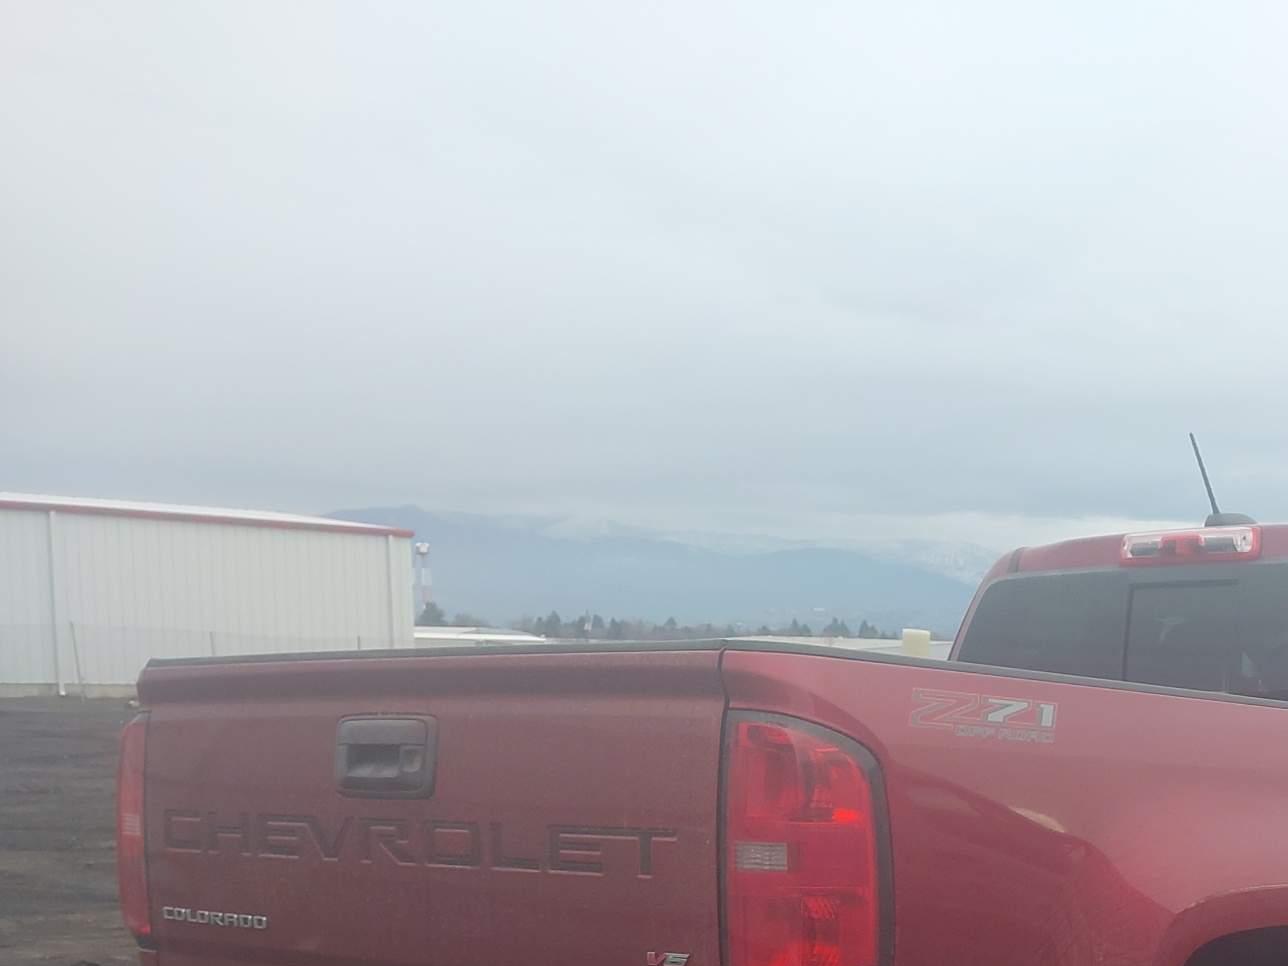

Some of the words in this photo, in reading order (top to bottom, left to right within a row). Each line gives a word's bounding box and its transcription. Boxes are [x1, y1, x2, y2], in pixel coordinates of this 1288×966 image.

[910, 687, 1058, 729] Z71
[164, 808, 678, 880] CHEVROLET
[162, 906, 267, 929] COLORADO
